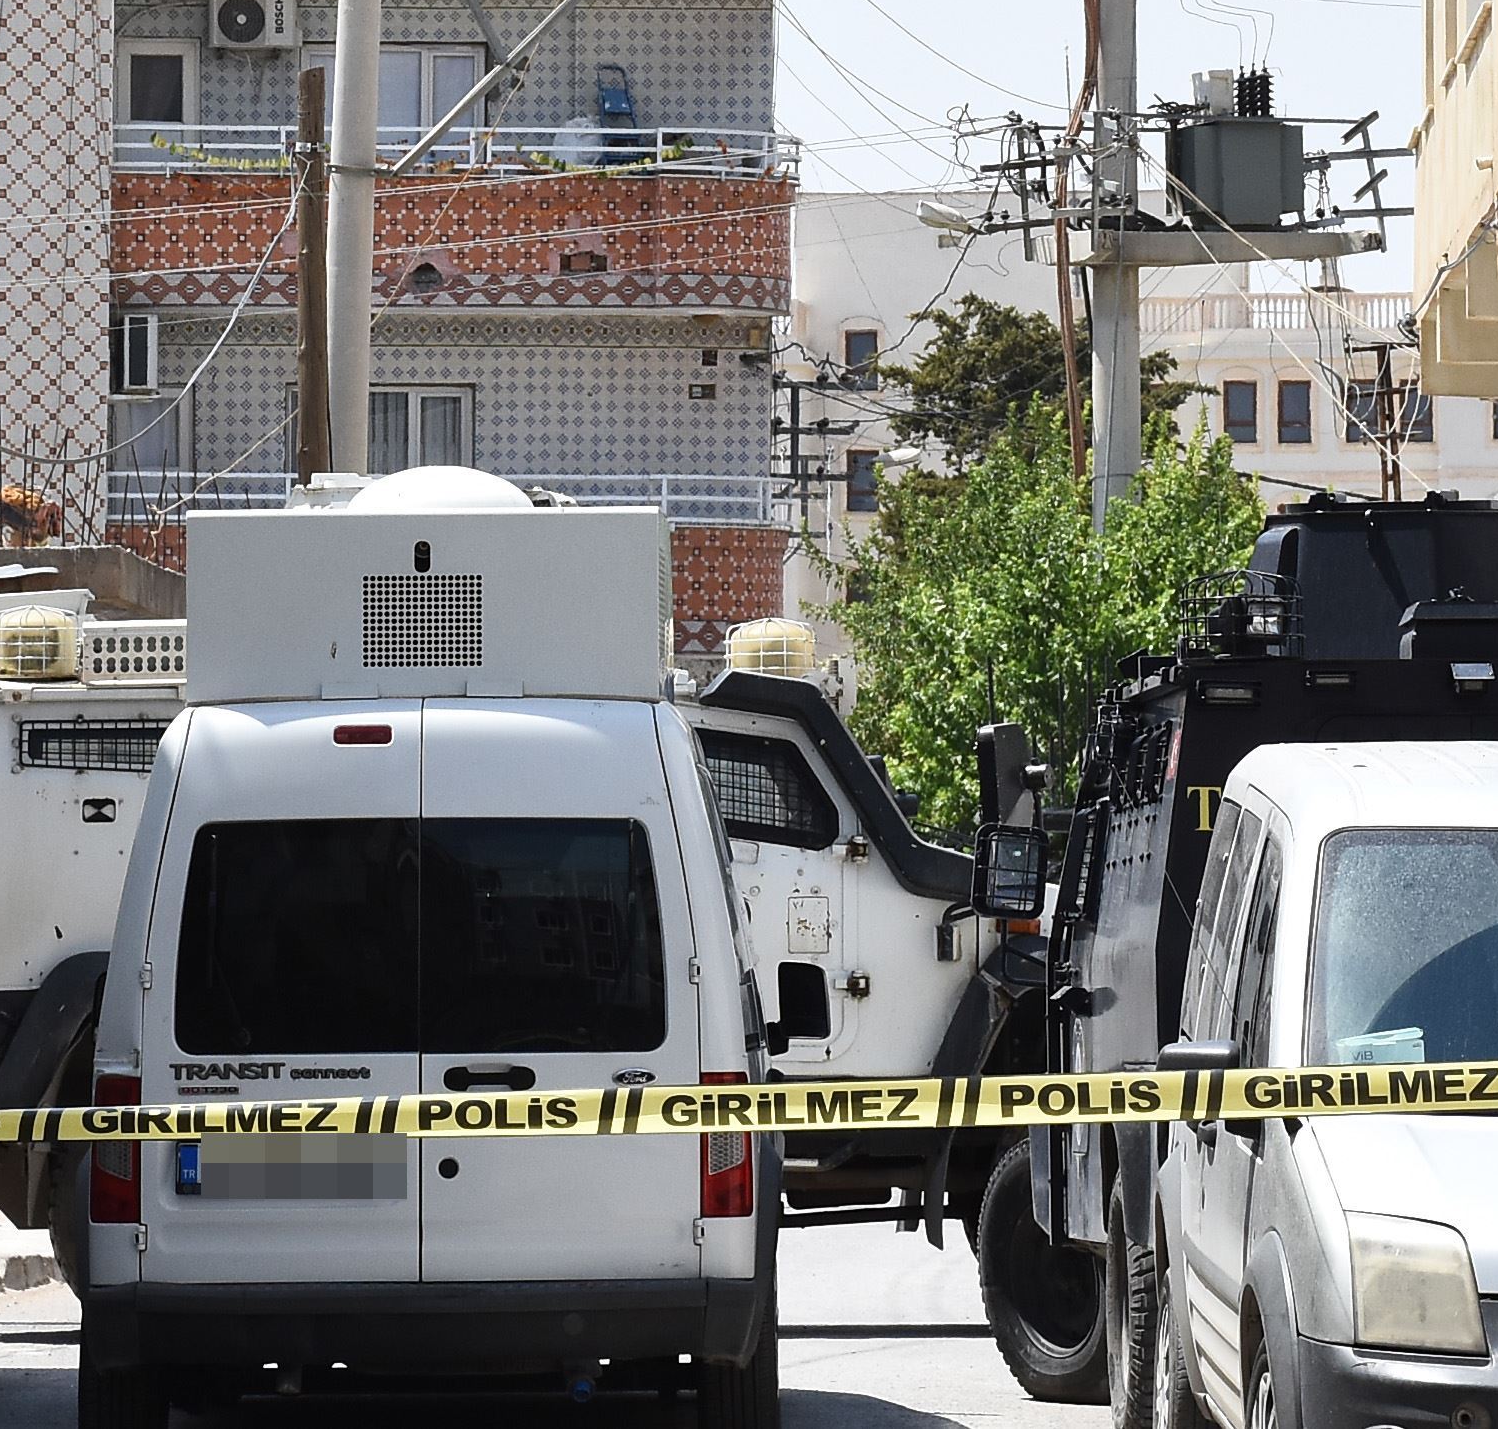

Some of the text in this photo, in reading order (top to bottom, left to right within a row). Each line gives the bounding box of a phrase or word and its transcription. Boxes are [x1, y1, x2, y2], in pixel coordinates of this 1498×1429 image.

[169, 1062, 372, 1080] TRANSIT connect
[182, 1169, 196, 1179] TR
